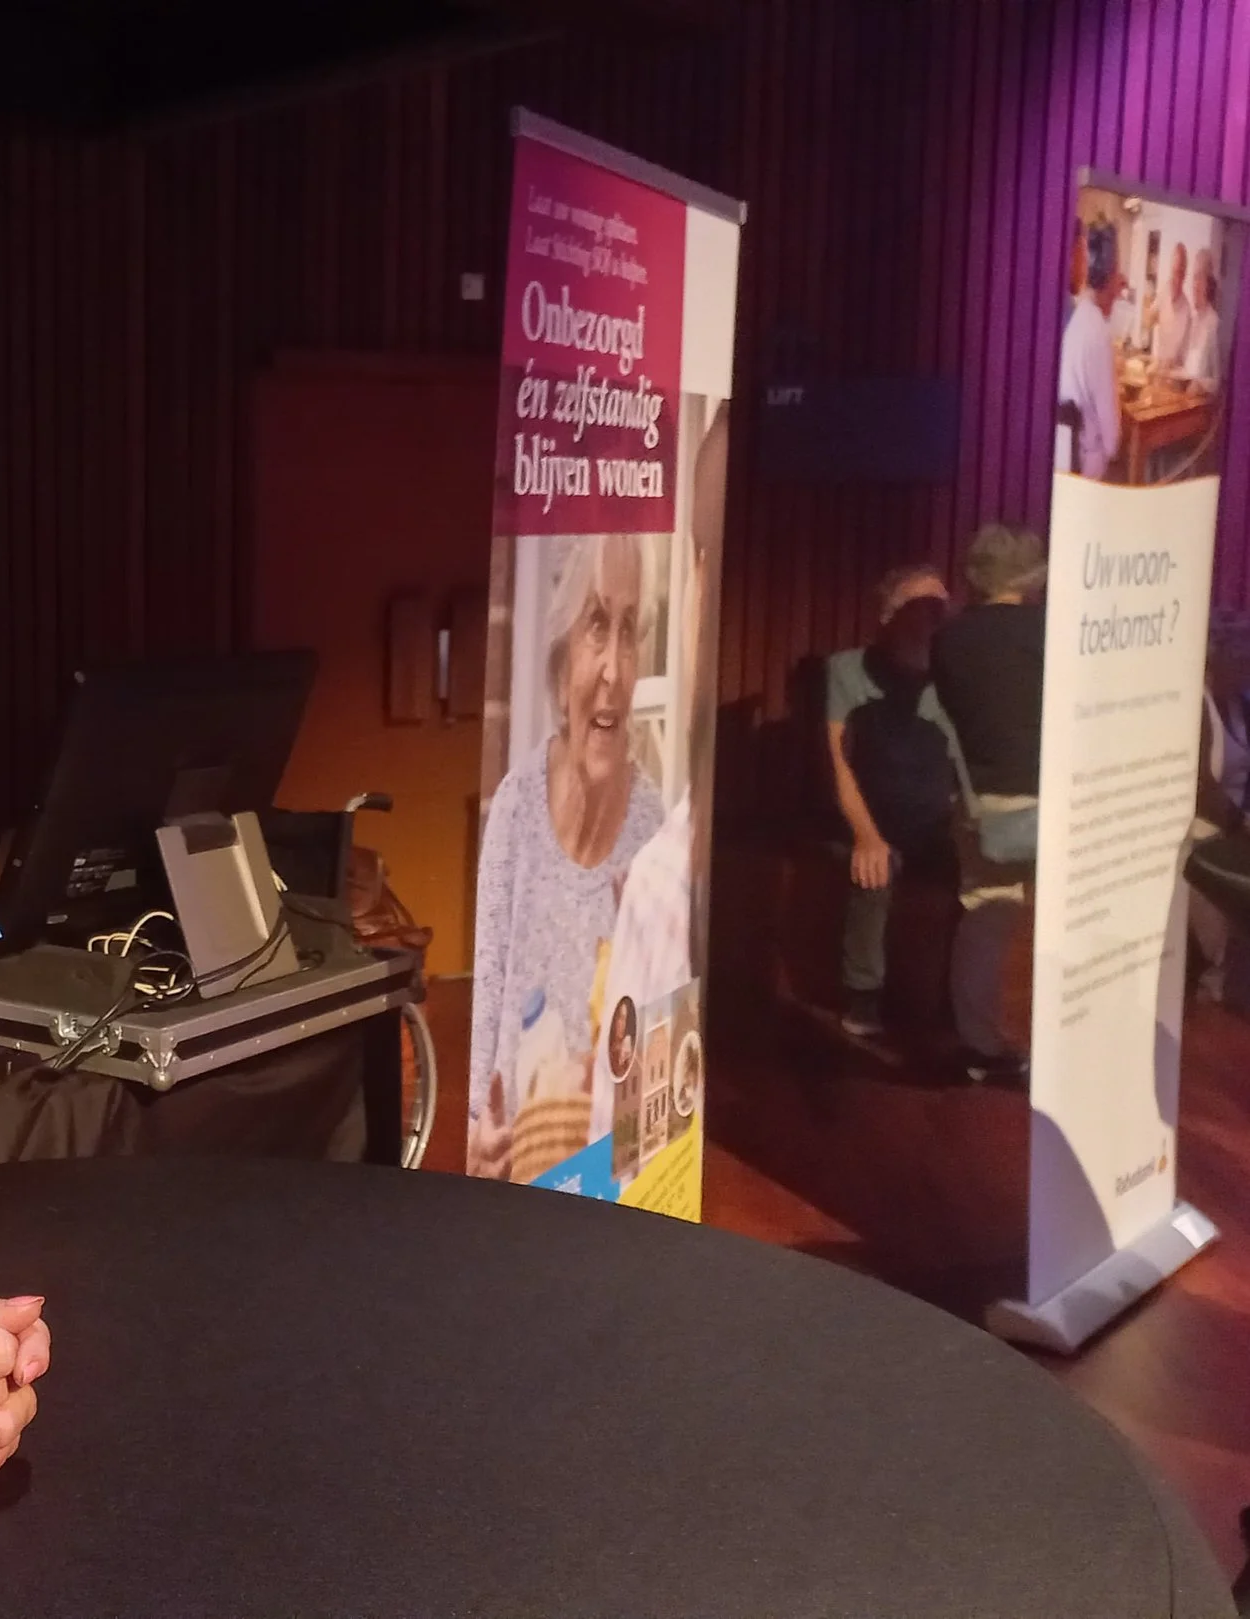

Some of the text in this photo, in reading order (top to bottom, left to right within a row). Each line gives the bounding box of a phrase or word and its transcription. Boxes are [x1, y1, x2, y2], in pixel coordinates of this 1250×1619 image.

[521, 280, 646, 375] Onbezorgd
[516, 358, 664, 449] én zelfstandig
[514, 432, 664, 515] blijven wonen
[1082, 542, 1177, 590] Uw woon-
